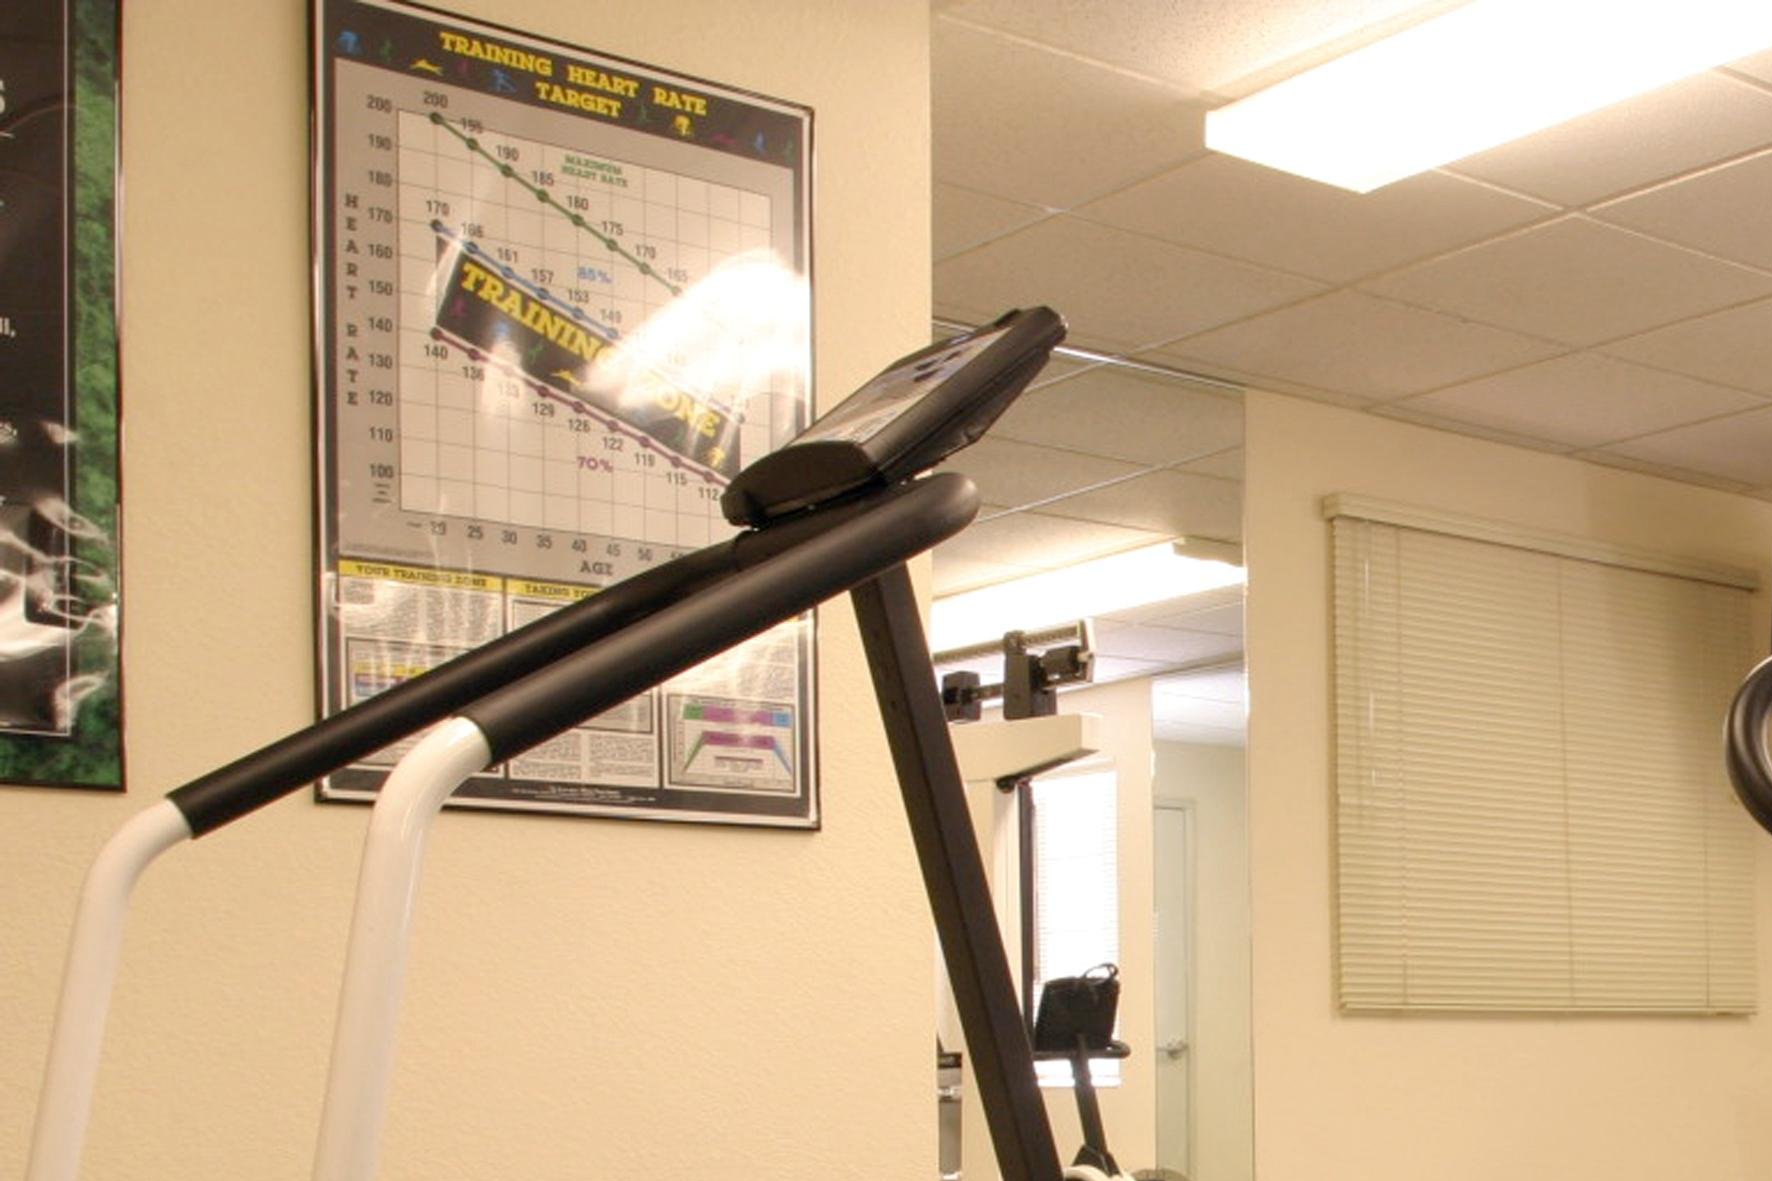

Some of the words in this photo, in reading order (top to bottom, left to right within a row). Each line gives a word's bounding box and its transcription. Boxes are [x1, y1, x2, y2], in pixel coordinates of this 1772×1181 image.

[440, 31, 553, 77] TRAINING
[567, 65, 640, 97] HEART
[654, 88, 707, 115] RATE
[366, 94, 392, 113] 200
[423, 91, 448, 109] 200
[536, 82, 622, 117] TARGET
[368, 134, 392, 151] 190
[497, 145, 519, 162] 190
[368, 170, 392, 188] 180
[532, 171, 554, 187] 185
[426, 200, 450, 216] 170
[566, 195, 589, 211] 180
[368, 208, 393, 224] 170
[602, 221, 623, 236] 175
[368, 243, 392, 260] 160
[498, 248, 518, 263] 161
[635, 244, 656, 260] 170
[531, 269, 554, 284] 157
[368, 280, 393, 296] 150
[568, 289, 590, 304] 153
[368, 317, 393, 333] 140
[424, 345, 448, 361] 140
[368, 354, 393, 370] 130
[369, 390, 393, 406] 120
[532, 403, 555, 418] 129
[369, 426, 393, 442] 110
[602, 436, 623, 452] 122
[369, 463, 394, 479] 100
[577, 456, 614, 474] 70%
[666, 472, 688, 486] 115
[699, 487, 719, 502] 112
[468, 525, 483, 540] 25
[502, 530, 518, 545] 30
[536, 534, 553, 549] 35
[572, 539, 587, 553] 40
[606, 543, 621, 558] 45
[580, 560, 614, 576] AGE
